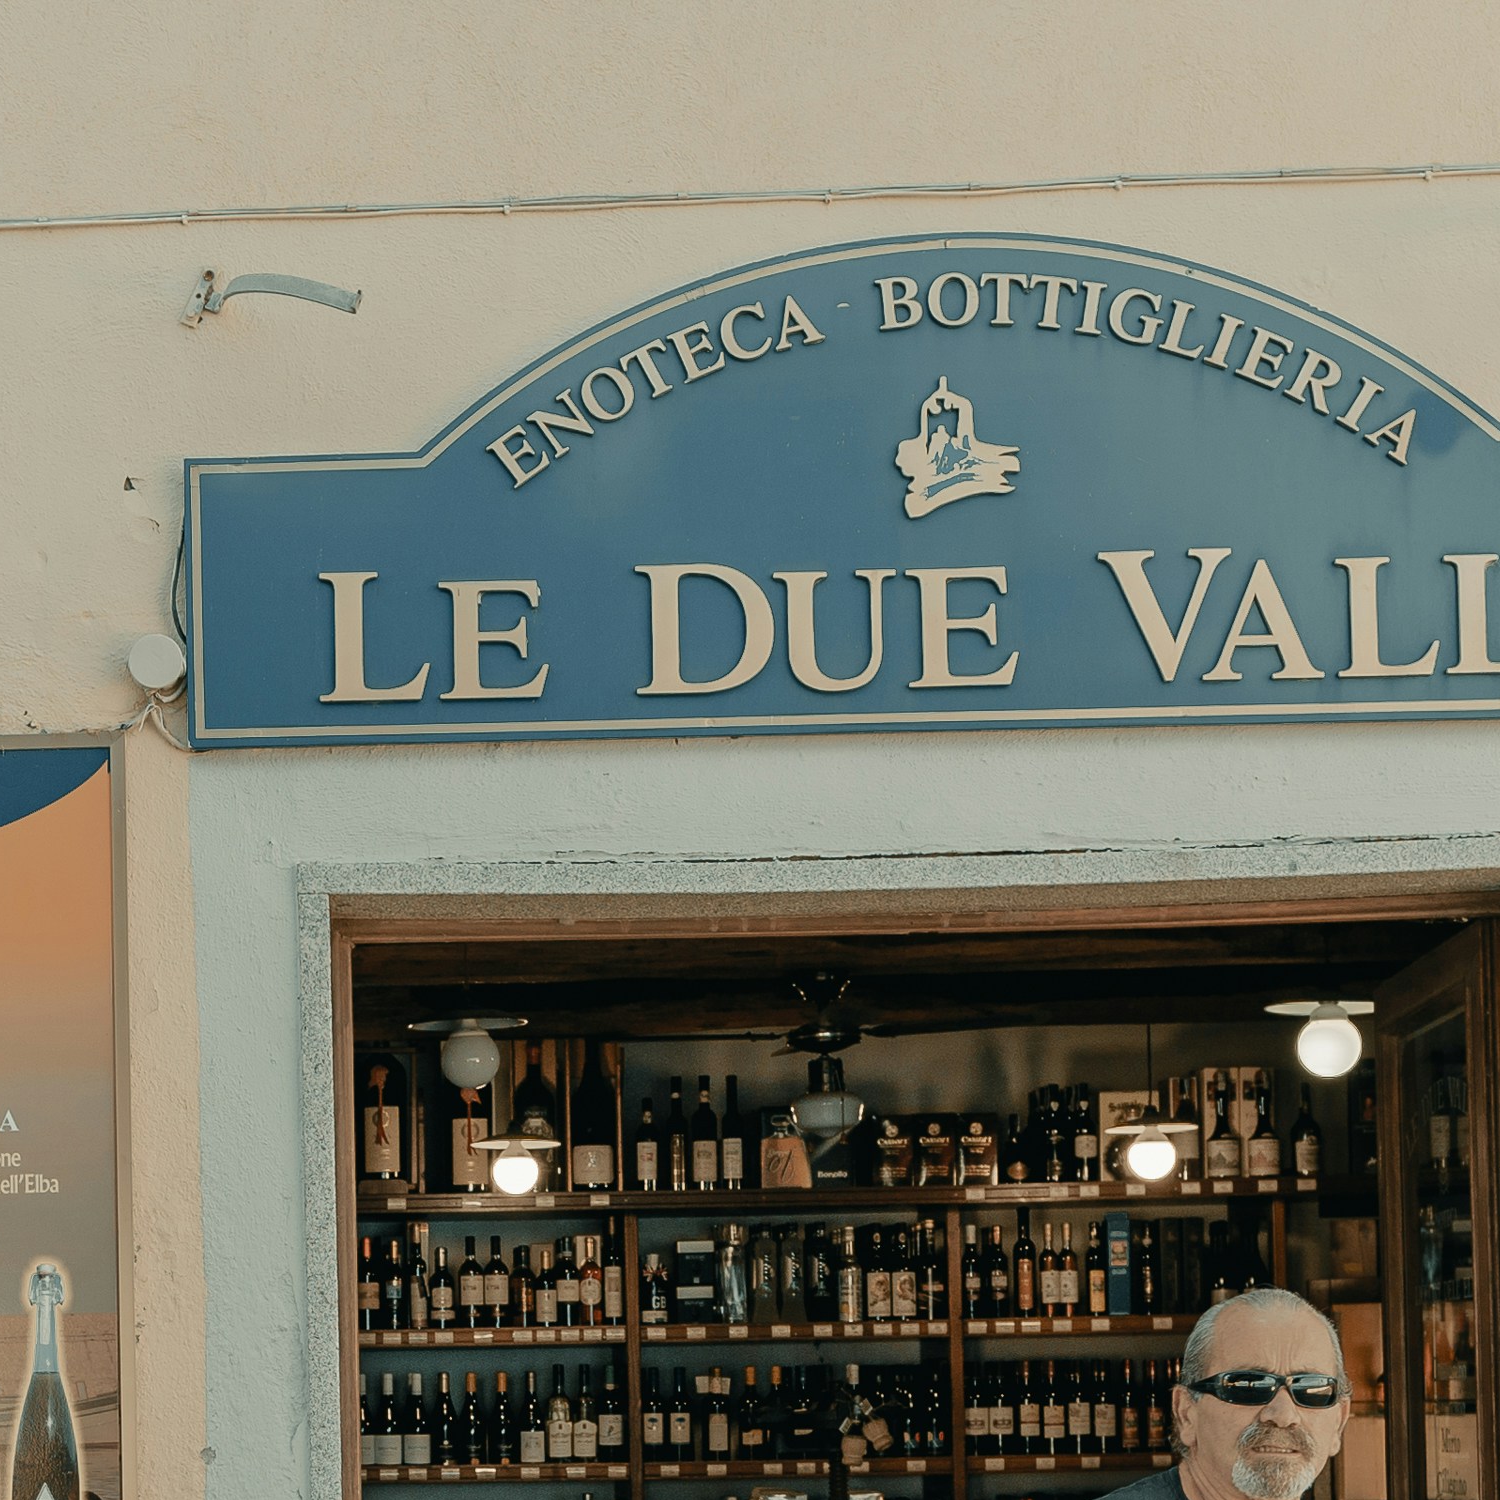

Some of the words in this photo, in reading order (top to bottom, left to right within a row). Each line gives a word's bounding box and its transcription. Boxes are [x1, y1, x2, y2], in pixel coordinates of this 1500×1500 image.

[485, 294, 826, 489] ENOTECA
[873, 271, 1418, 466] BOTTIGLIERIA
[318, 569, 550, 703] LE
[633, 562, 1020, 695] DUE
